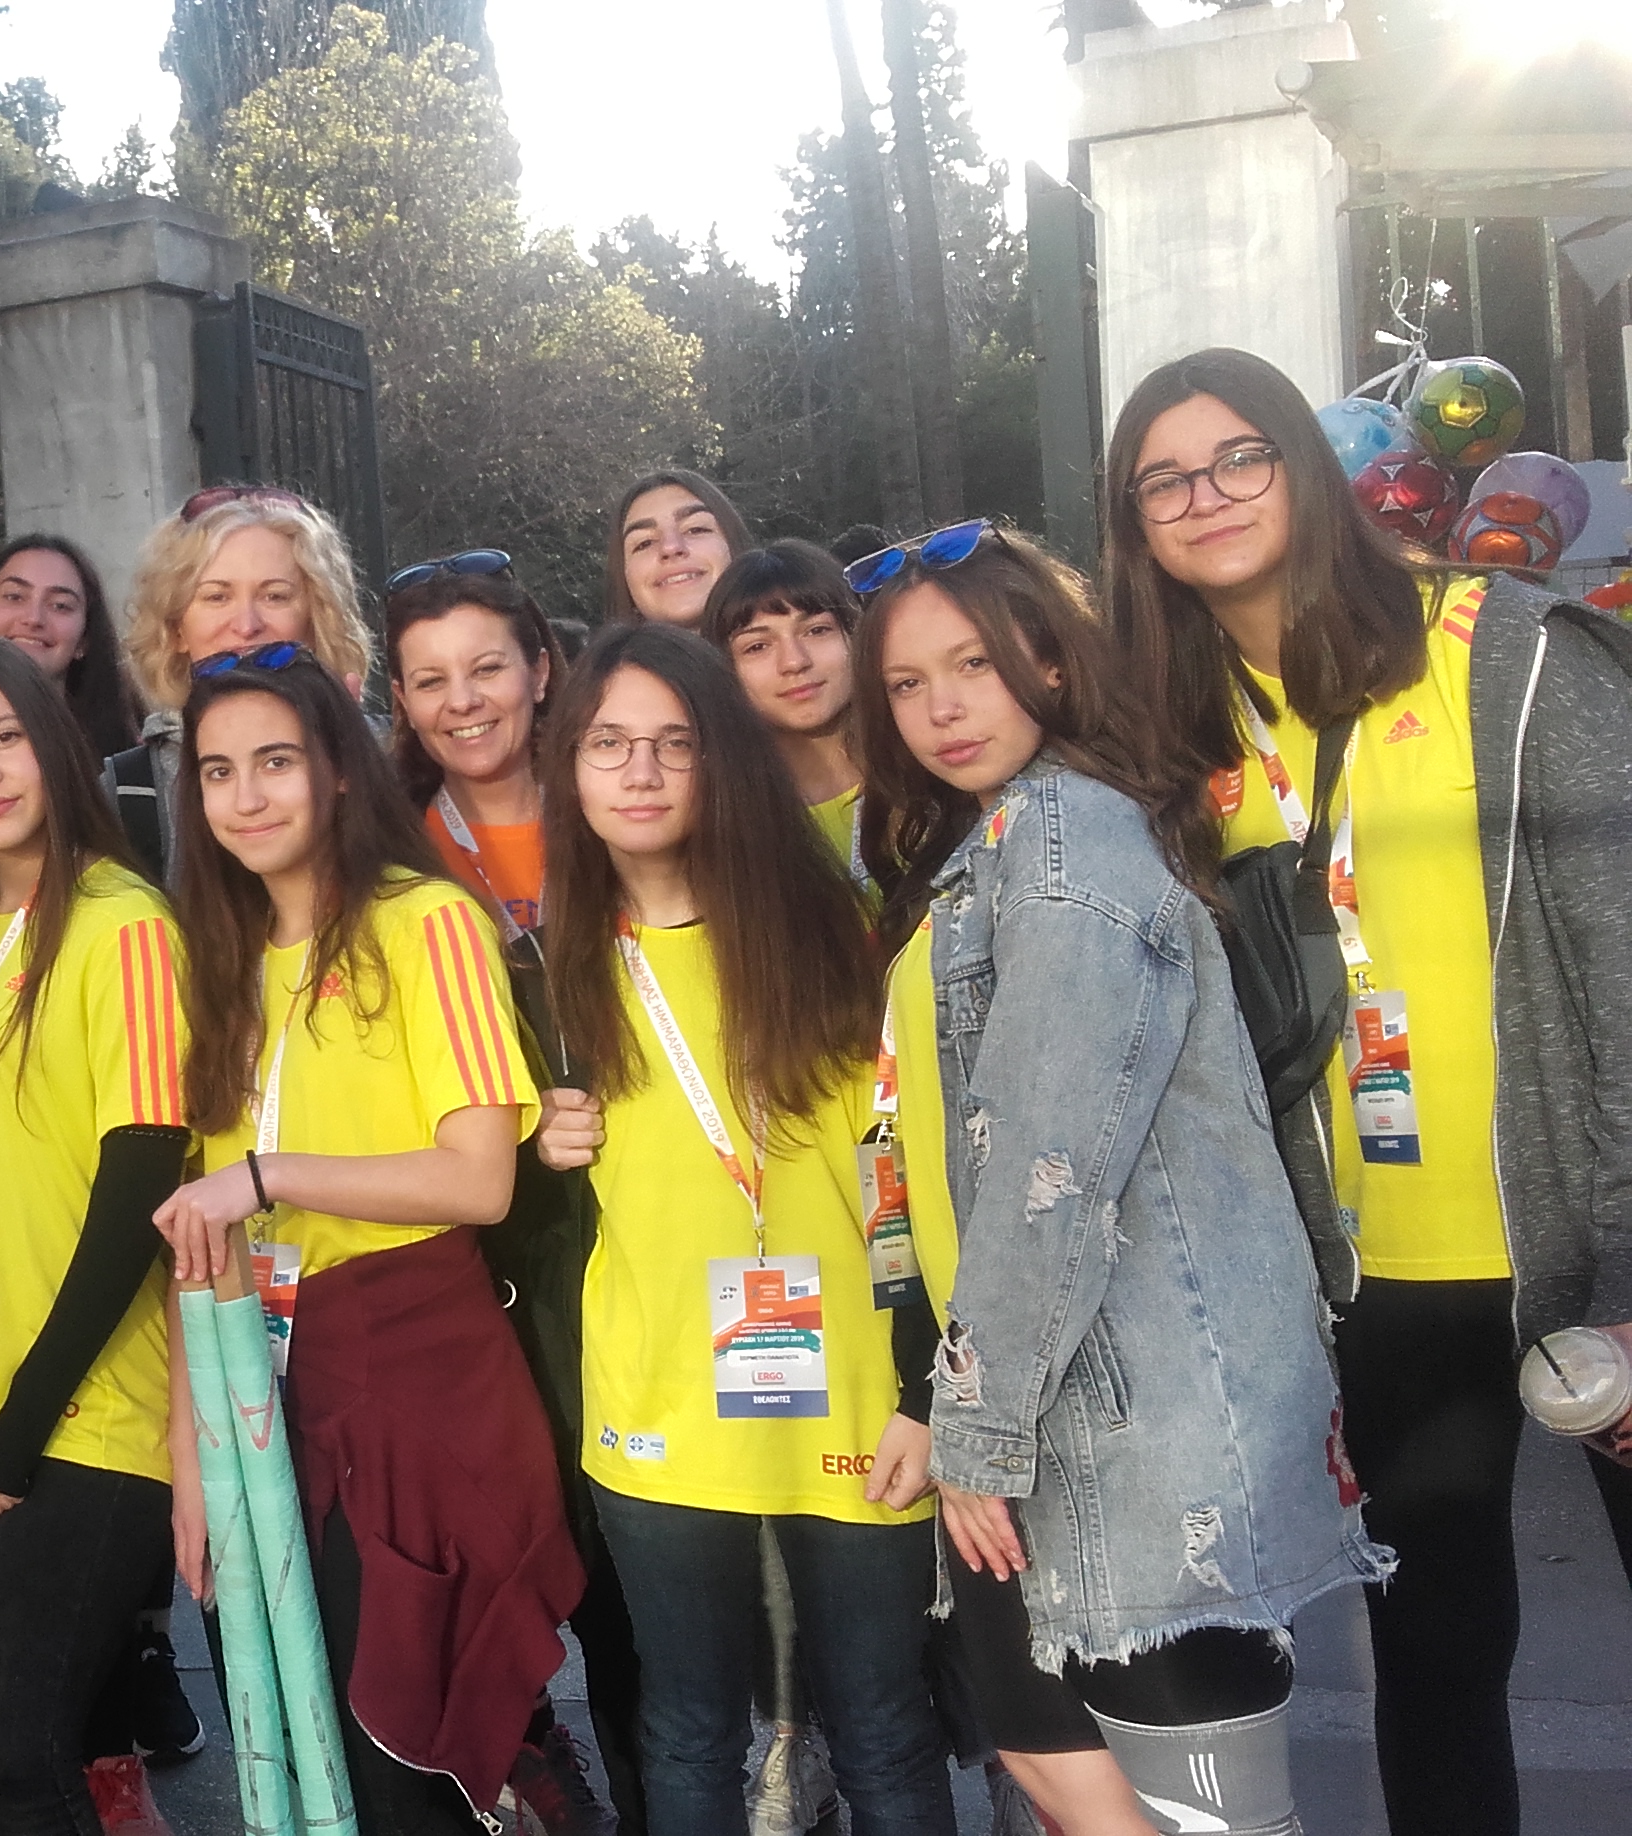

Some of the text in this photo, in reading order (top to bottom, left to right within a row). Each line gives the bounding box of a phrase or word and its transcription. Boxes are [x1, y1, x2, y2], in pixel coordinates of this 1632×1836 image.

[652, 1003, 711, 1108] ΗΜΙΜΑΡΑΘΩΝΙΟΣ
[701, 1108, 726, 1142] 2019
[263, 1098, 278, 1153] ARATHON
[757, 1371, 784, 1381] ERGO
[821, 1453, 876, 1476] ERGO
